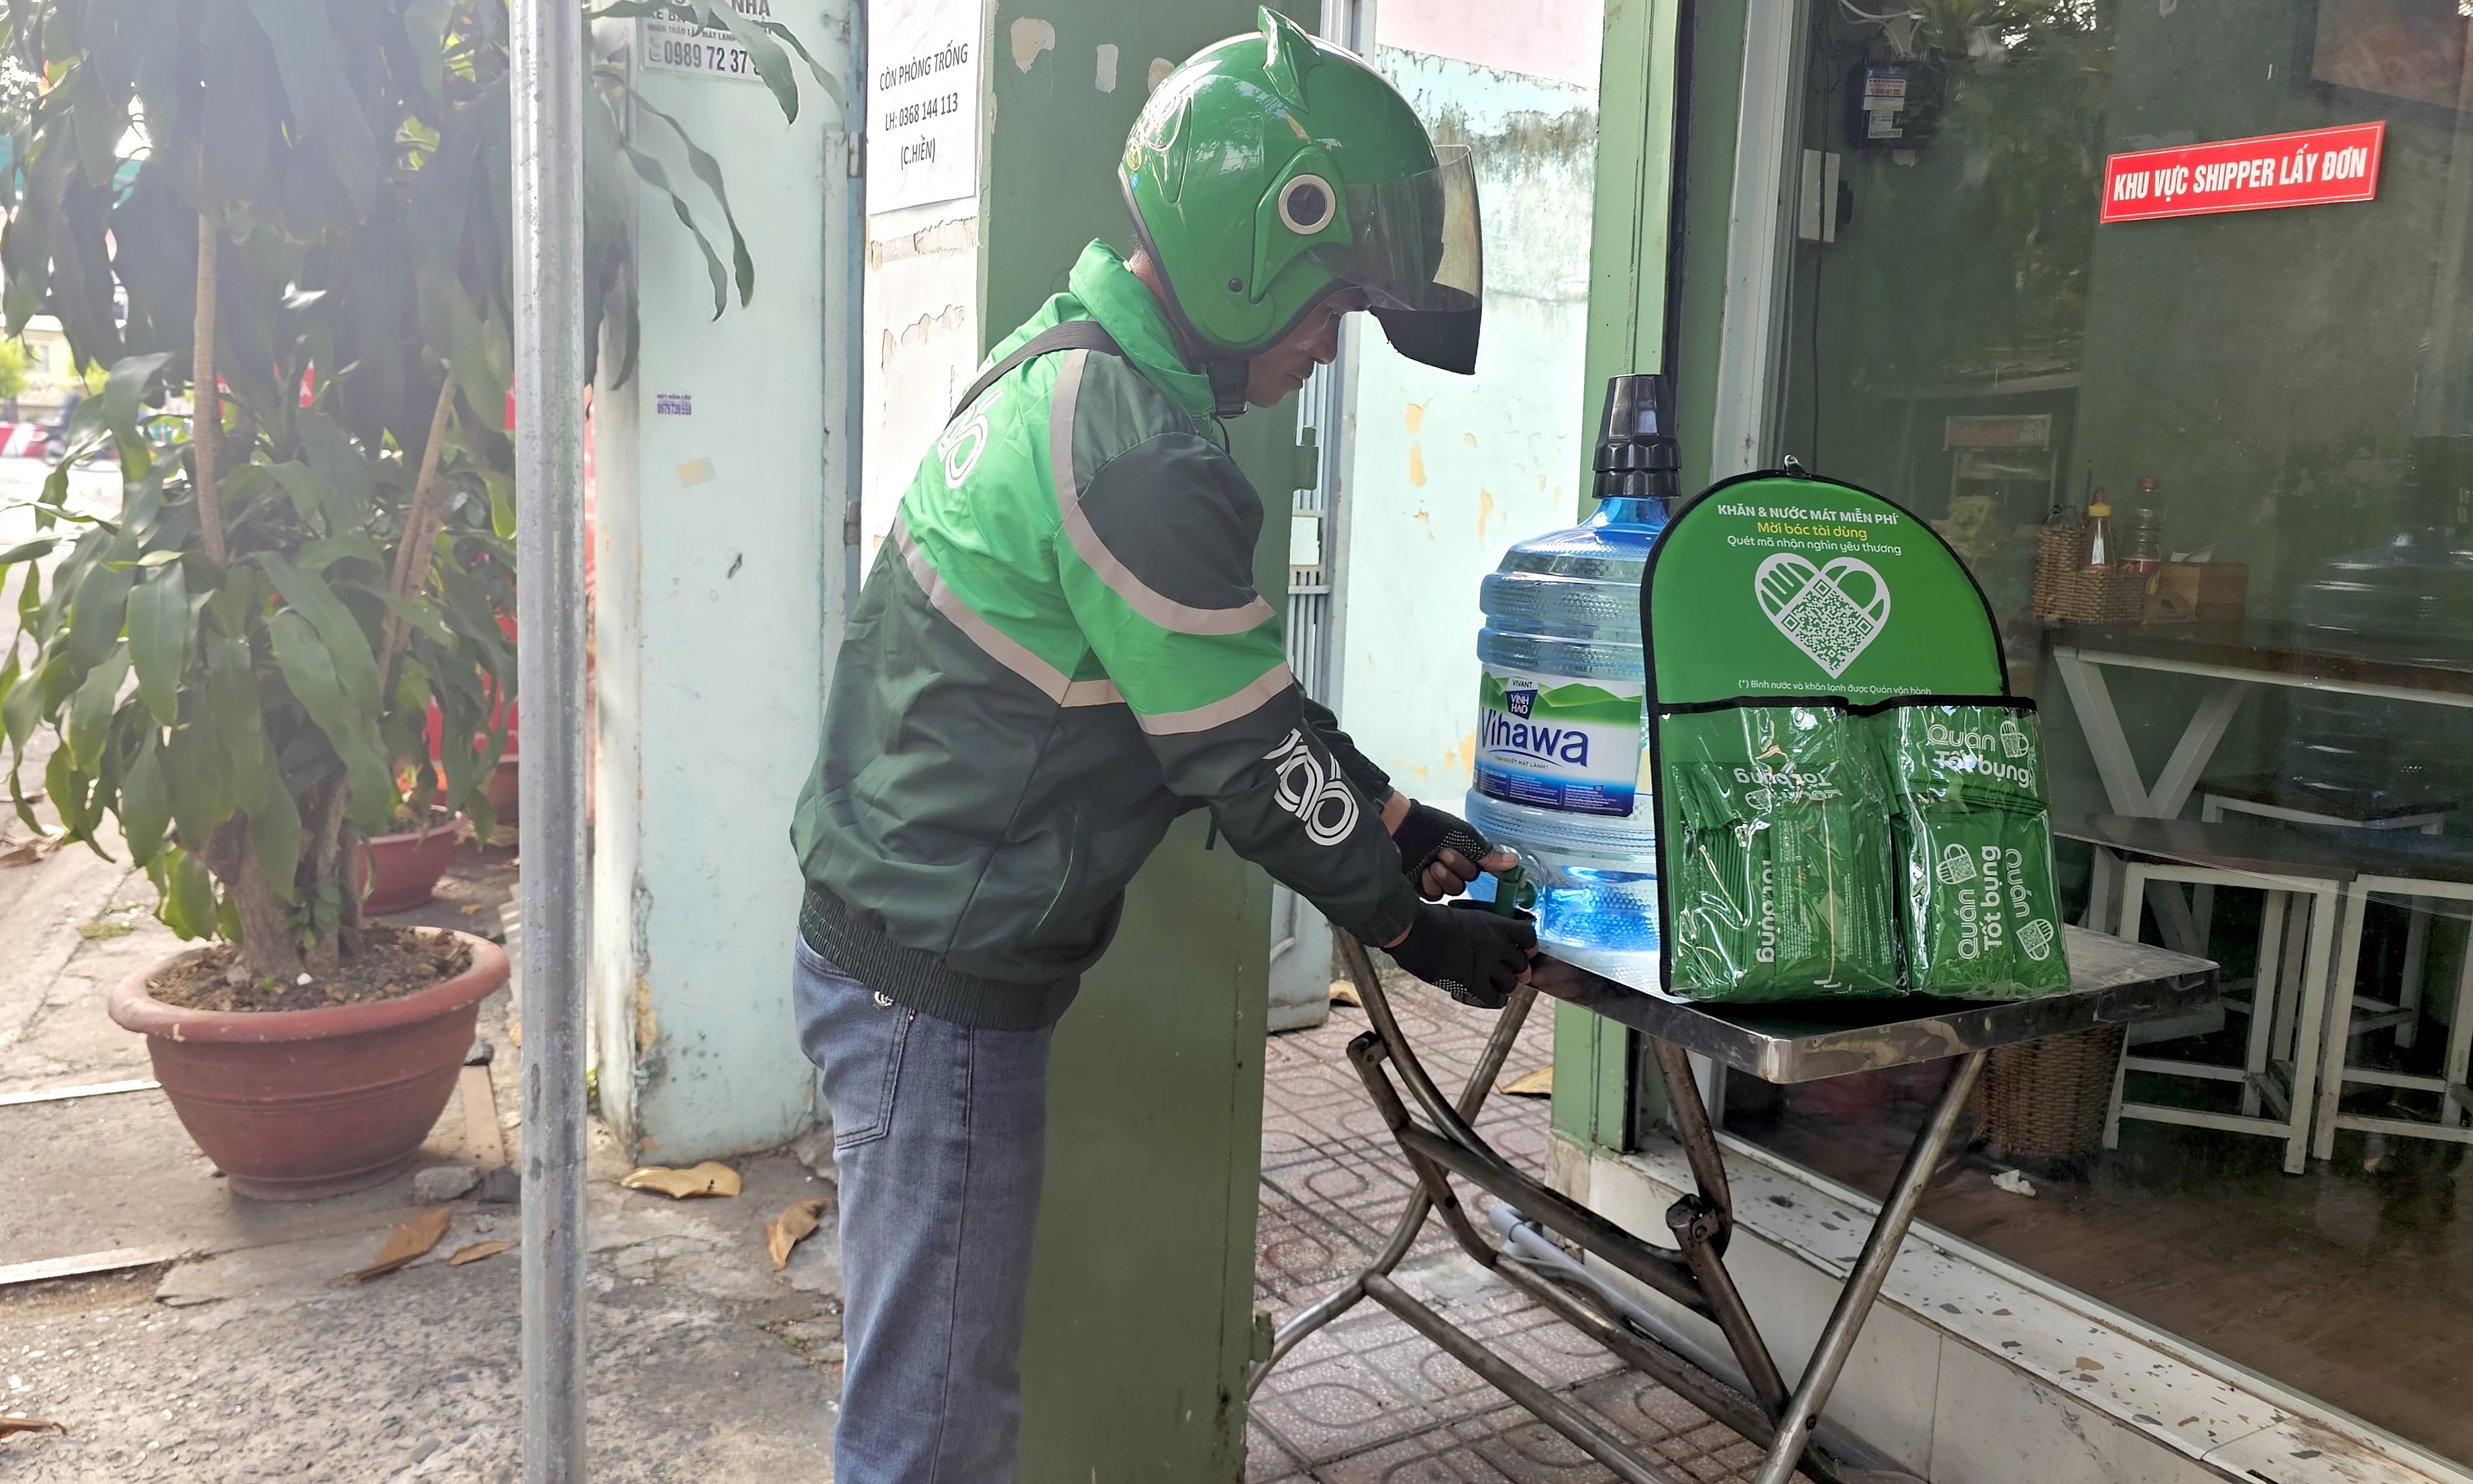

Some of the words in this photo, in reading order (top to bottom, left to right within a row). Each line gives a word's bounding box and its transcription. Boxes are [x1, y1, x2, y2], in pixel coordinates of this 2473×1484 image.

[664, 40, 702, 68] 0989
[706, 46, 725, 72] 72
[730, 48, 748, 74] 37
[880, 66, 897, 91] CÒN
[899, 56, 931, 85] PHÒNG
[934, 39, 968, 72] TRỐNG
[886, 111, 897, 131] LH:
[899, 104, 919, 127] 0368
[922, 97, 938, 121] 144
[941, 92, 958, 115] 113
[900, 134, 935, 170] (C.HIỀN)
[2113, 170, 2150, 201] KHU
[2154, 165, 2189, 201] VỰC
[2193, 158, 2275, 193] SHIPPER
[2280, 144, 2319, 185] LẤY
[2321, 146, 2368, 181] ĐƠN
[1718, 503, 1755, 517] KHĂN
[1758, 507, 1767, 517] &
[1770, 506, 1807, 519] NƯỚC
[1810, 508, 1836, 521] MÁT
[1840, 508, 1873, 523] MIỄN
[1727, 535, 1755, 547] Quét
[1757, 537, 1775, 547] mã
[1777, 538, 1805, 549] nhận
[1840, 540, 1860, 553] yêu
[1862, 543, 1901, 555] thương
[1757, 522, 1782, 533] Mời
[1785, 523, 1810, 535] bác
[1812, 525, 1830, 536] tài
[1833, 526, 1868, 541] dùng
[1512, 679, 1532, 688] VIVANT
[1751, 680, 1769, 688] Bình
[1771, 682, 1792, 690] nước
[1793, 682, 1803, 690] và
[1805, 682, 1826, 691] khăn
[1828, 683, 1846, 693] lạnh
[1848, 684, 1869, 694] được
[1871, 685, 1892, 694] Quán
[1893, 686, 1909, 696] vận
[1910, 686, 1932, 695] hành
[1481, 706, 1589, 768] Vihawa
[1928, 723, 1996, 752] Quán
[1979, 754, 2030, 788] bụng
[1980, 846, 2003, 907] bụng
[2005, 848, 2032, 918] Quán
[1953, 889, 1979, 959] Quán
[1979, 912, 2002, 951] Tốt
